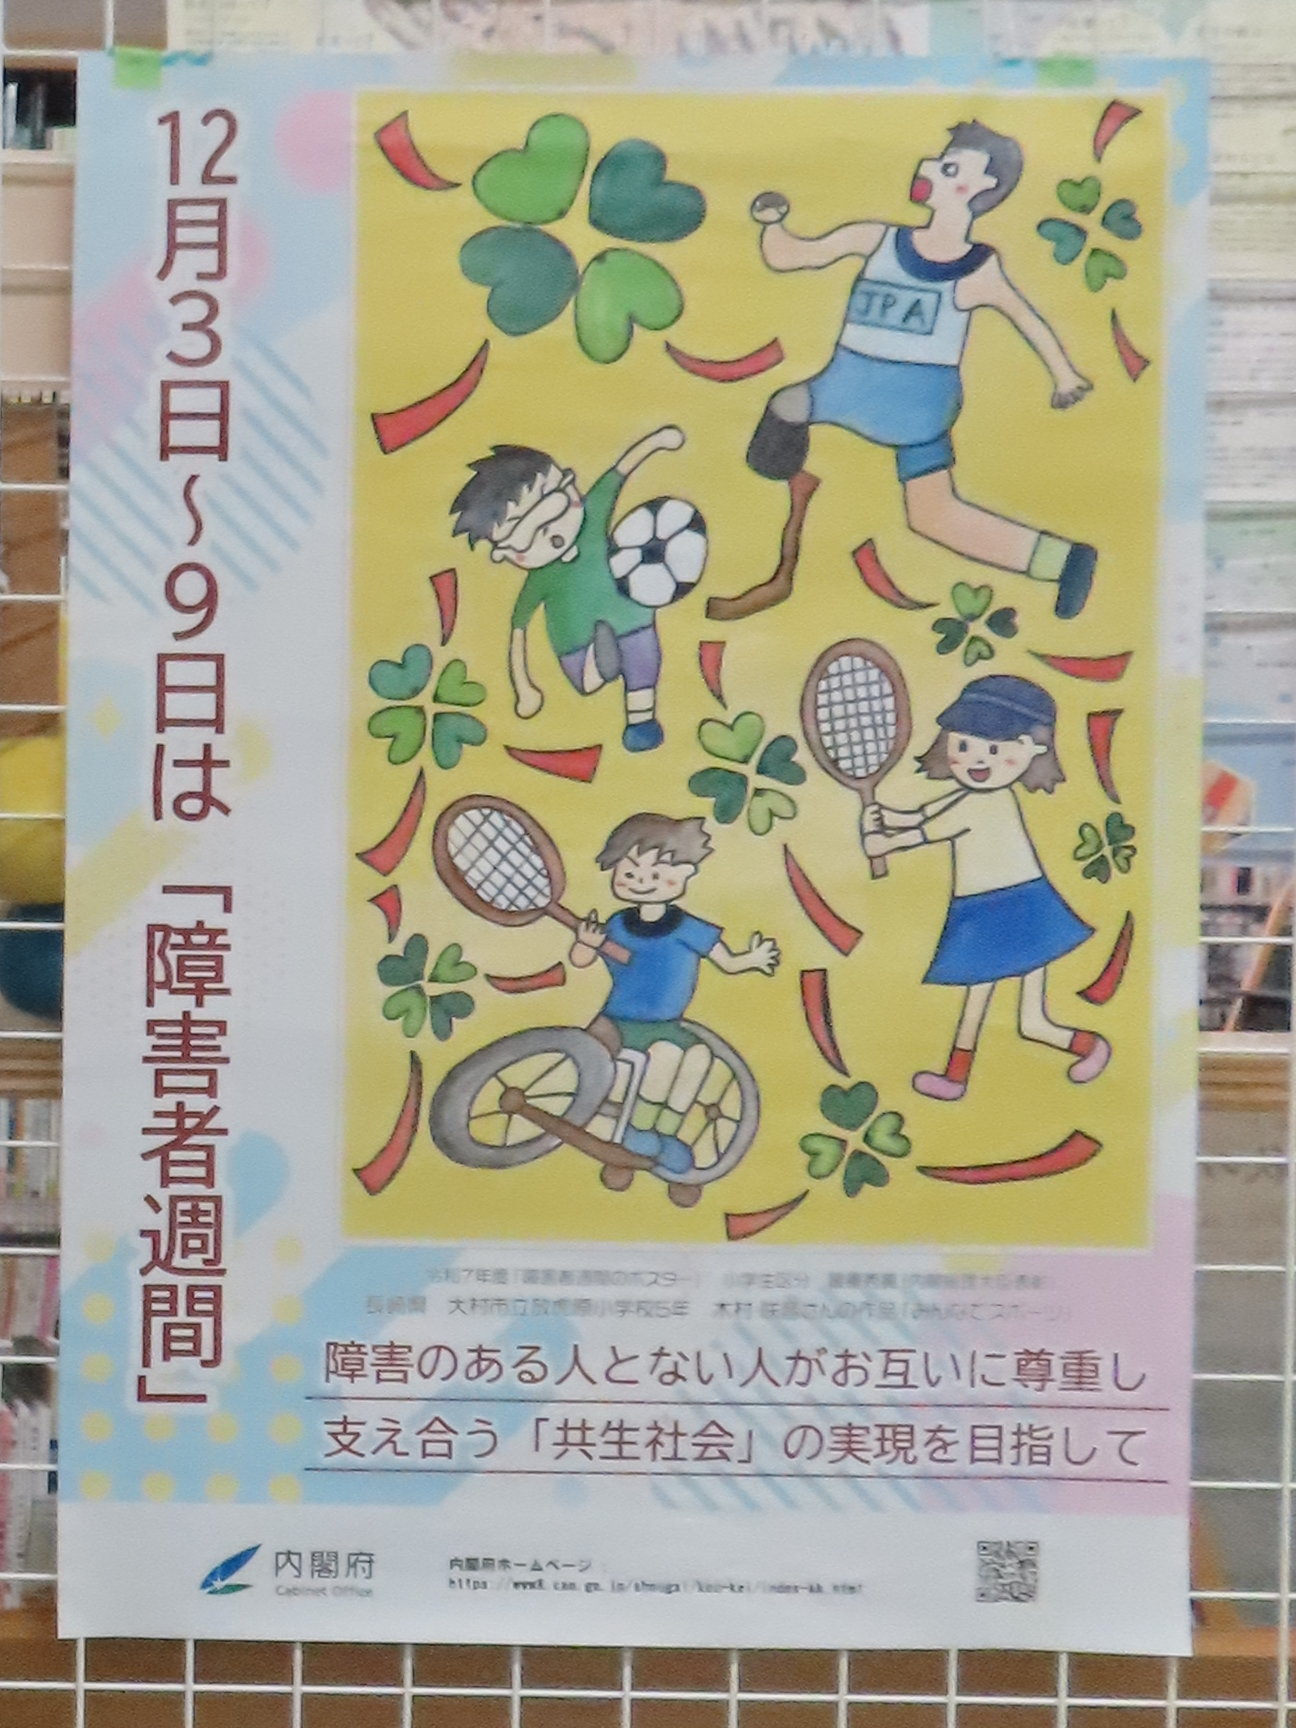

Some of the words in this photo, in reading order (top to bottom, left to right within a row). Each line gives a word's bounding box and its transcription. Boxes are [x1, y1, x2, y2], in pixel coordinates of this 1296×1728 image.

[322, 1343, 1147, 1394] 障害のある人とない人がお互いに尊重し
[322, 1416, 1145, 1469] 支え合う「共生社会」の実現を目指して
[273, 1549, 375, 1580] 内閣府
